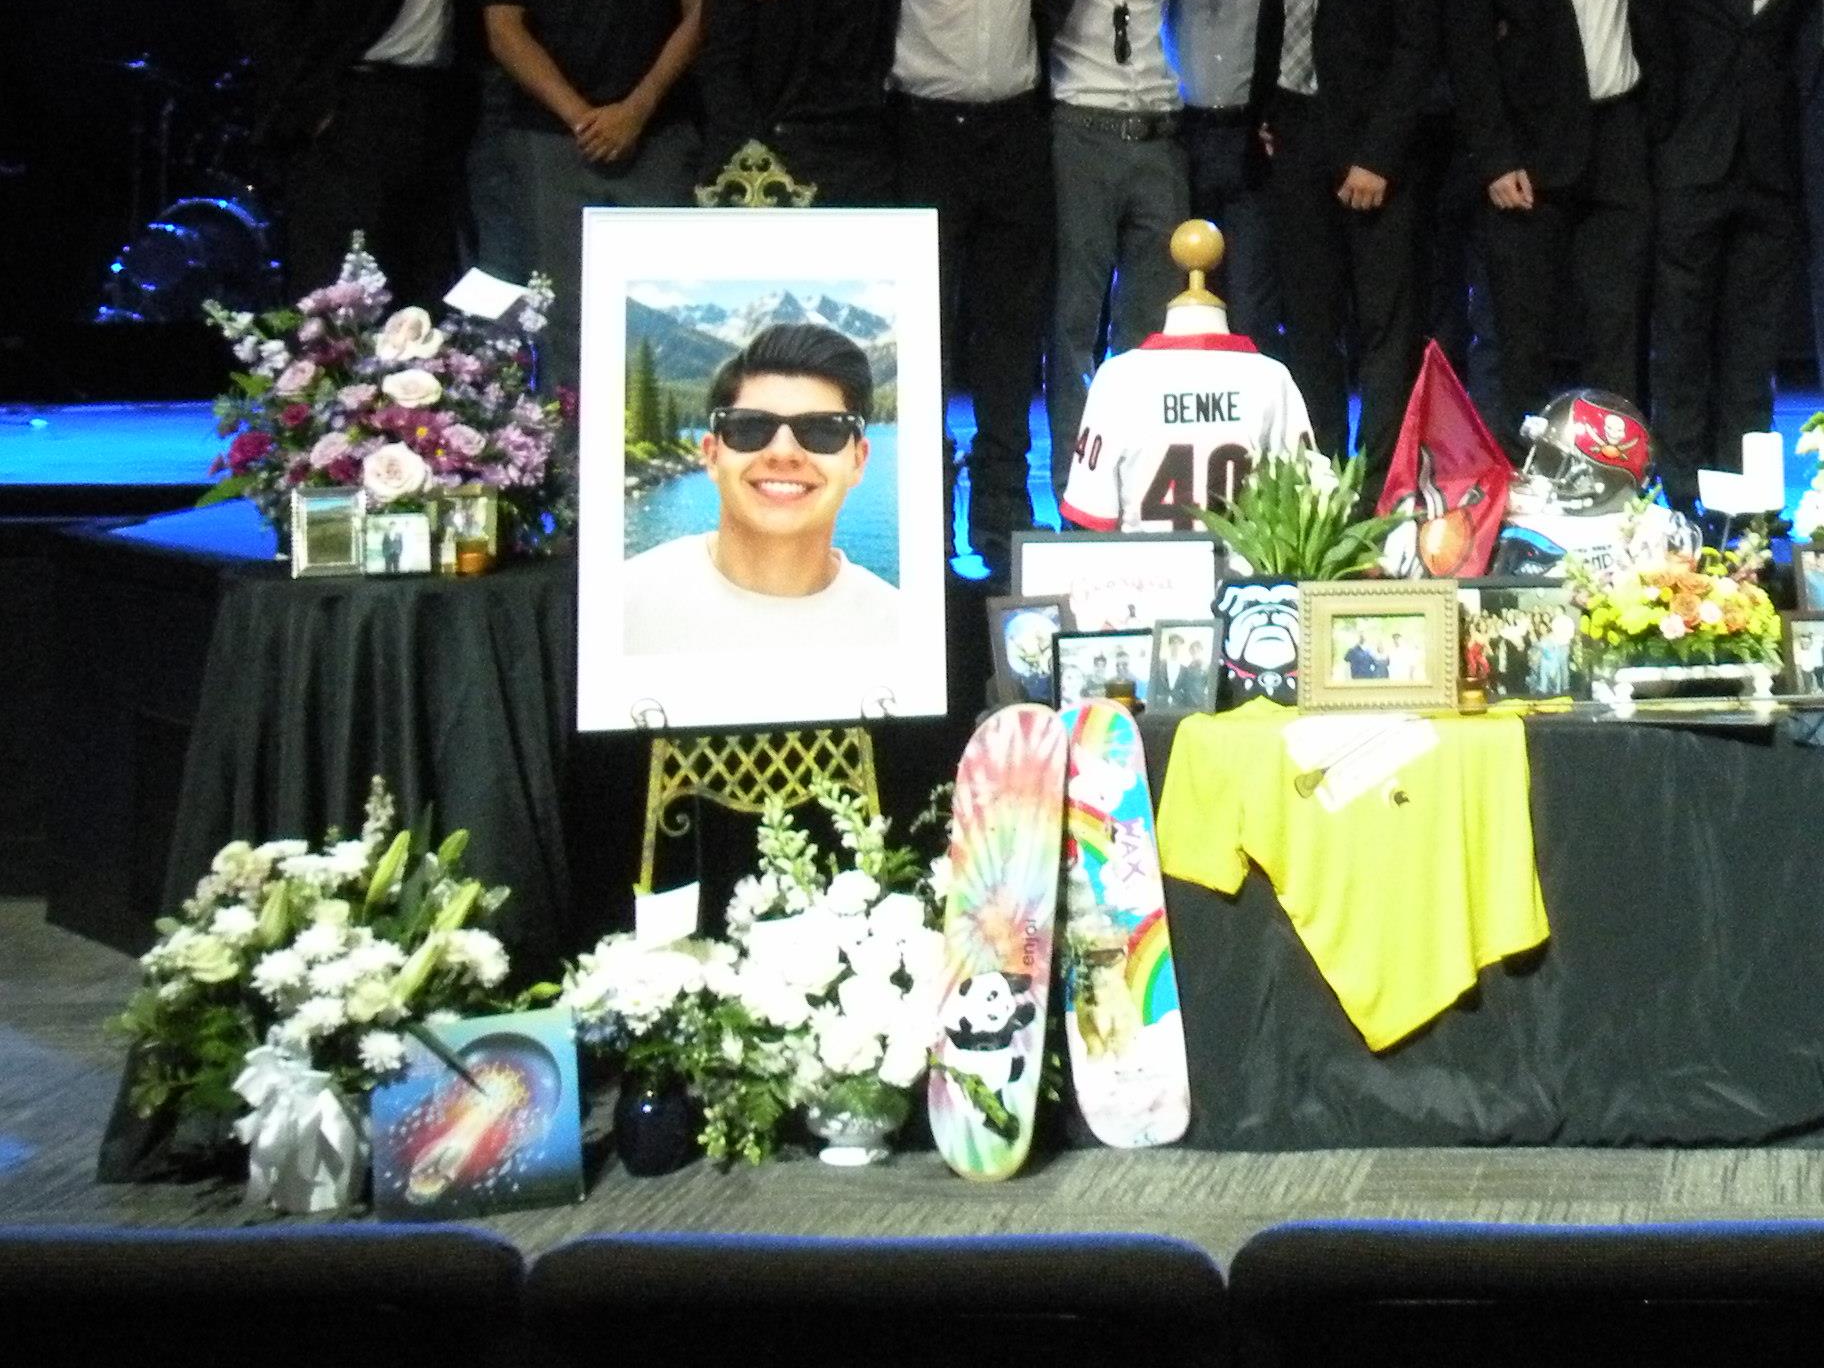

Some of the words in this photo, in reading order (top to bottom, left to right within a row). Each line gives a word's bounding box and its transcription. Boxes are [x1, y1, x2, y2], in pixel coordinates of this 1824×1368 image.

[1163, 391, 1240, 423] BENKE
[1074, 427, 1102, 471] 40
[1140, 443, 1252, 531] 40
